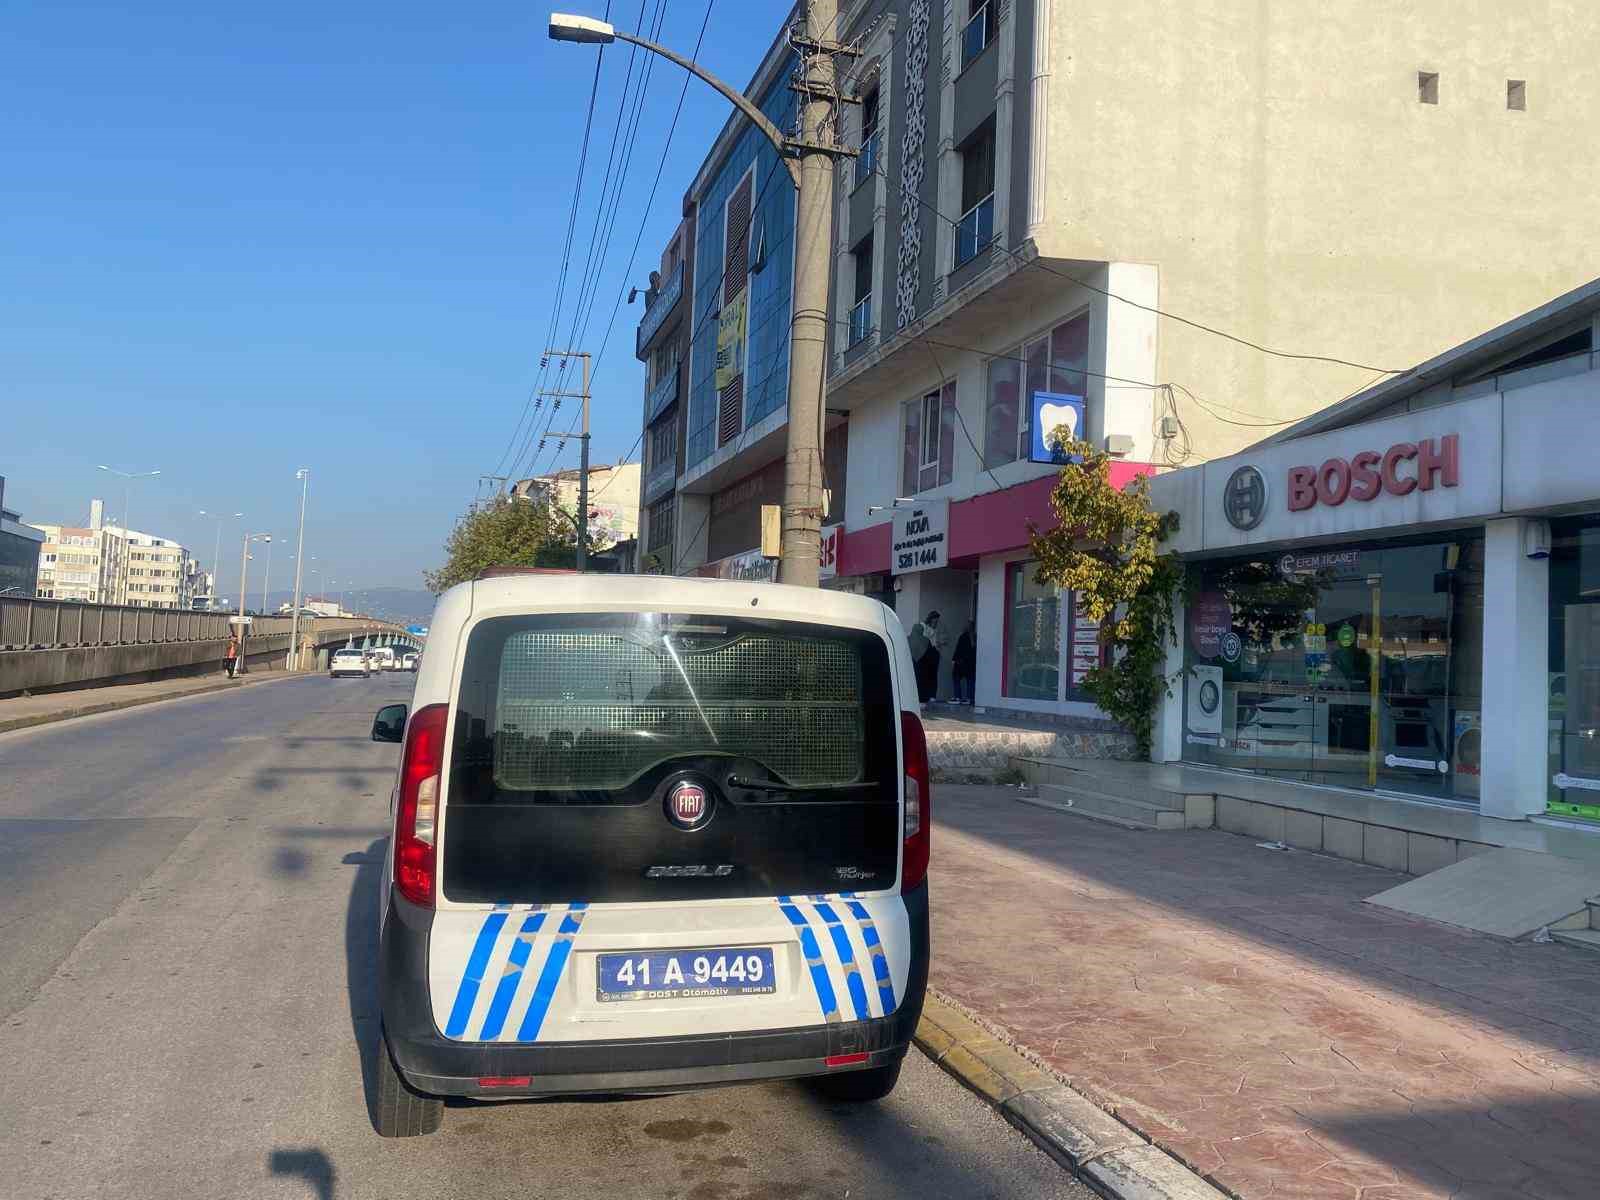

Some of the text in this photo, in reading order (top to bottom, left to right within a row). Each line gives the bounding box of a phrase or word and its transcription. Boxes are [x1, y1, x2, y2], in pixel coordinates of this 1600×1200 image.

[1287, 432, 1460, 513] BOSCH
[679, 794, 701, 813] FIAT
[616, 955, 764, 986] 41 A 9449
